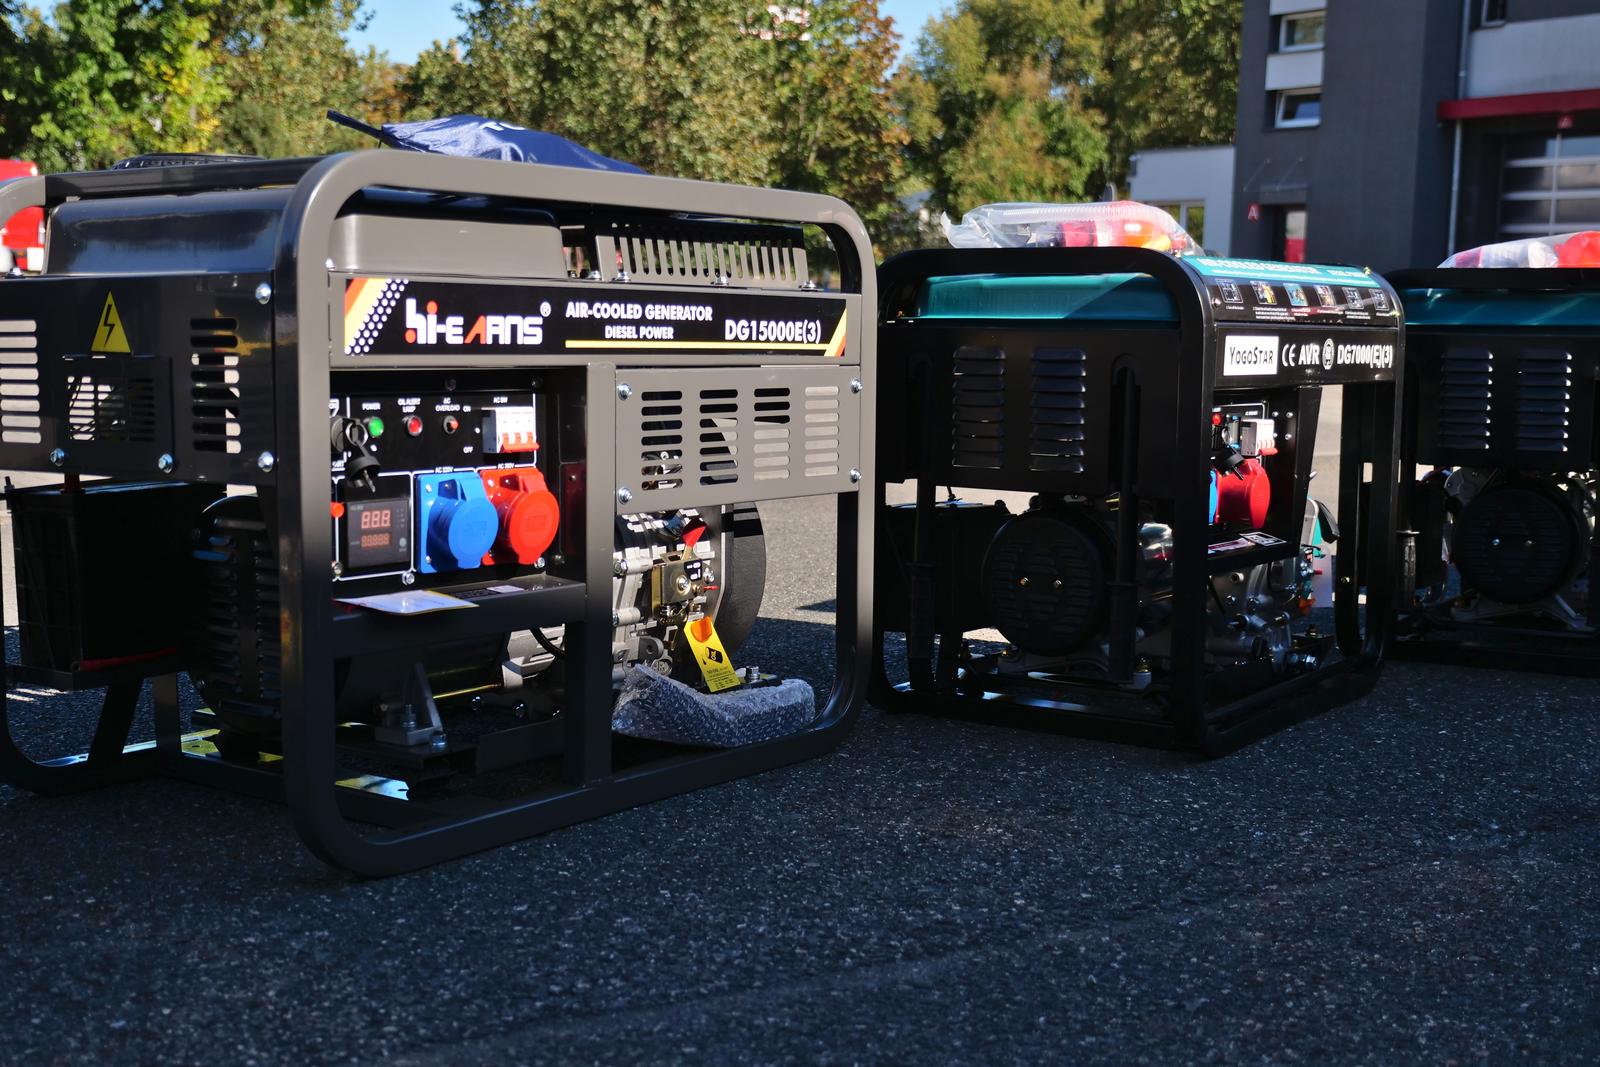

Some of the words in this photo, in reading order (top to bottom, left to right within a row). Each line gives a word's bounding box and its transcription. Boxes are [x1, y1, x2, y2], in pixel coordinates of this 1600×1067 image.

[565, 301, 642, 319] AIR-COOLED
[645, 304, 713, 321] GENERATOR
[605, 325, 638, 339] DIESEL
[639, 325, 674, 339] POWER
[724, 319, 821, 344] DG15000E(3)
[1298, 344, 1320, 366] AVR
[1337, 344, 1393, 369] DG7000(E)(3)
[463, 446, 473, 454] OFF
